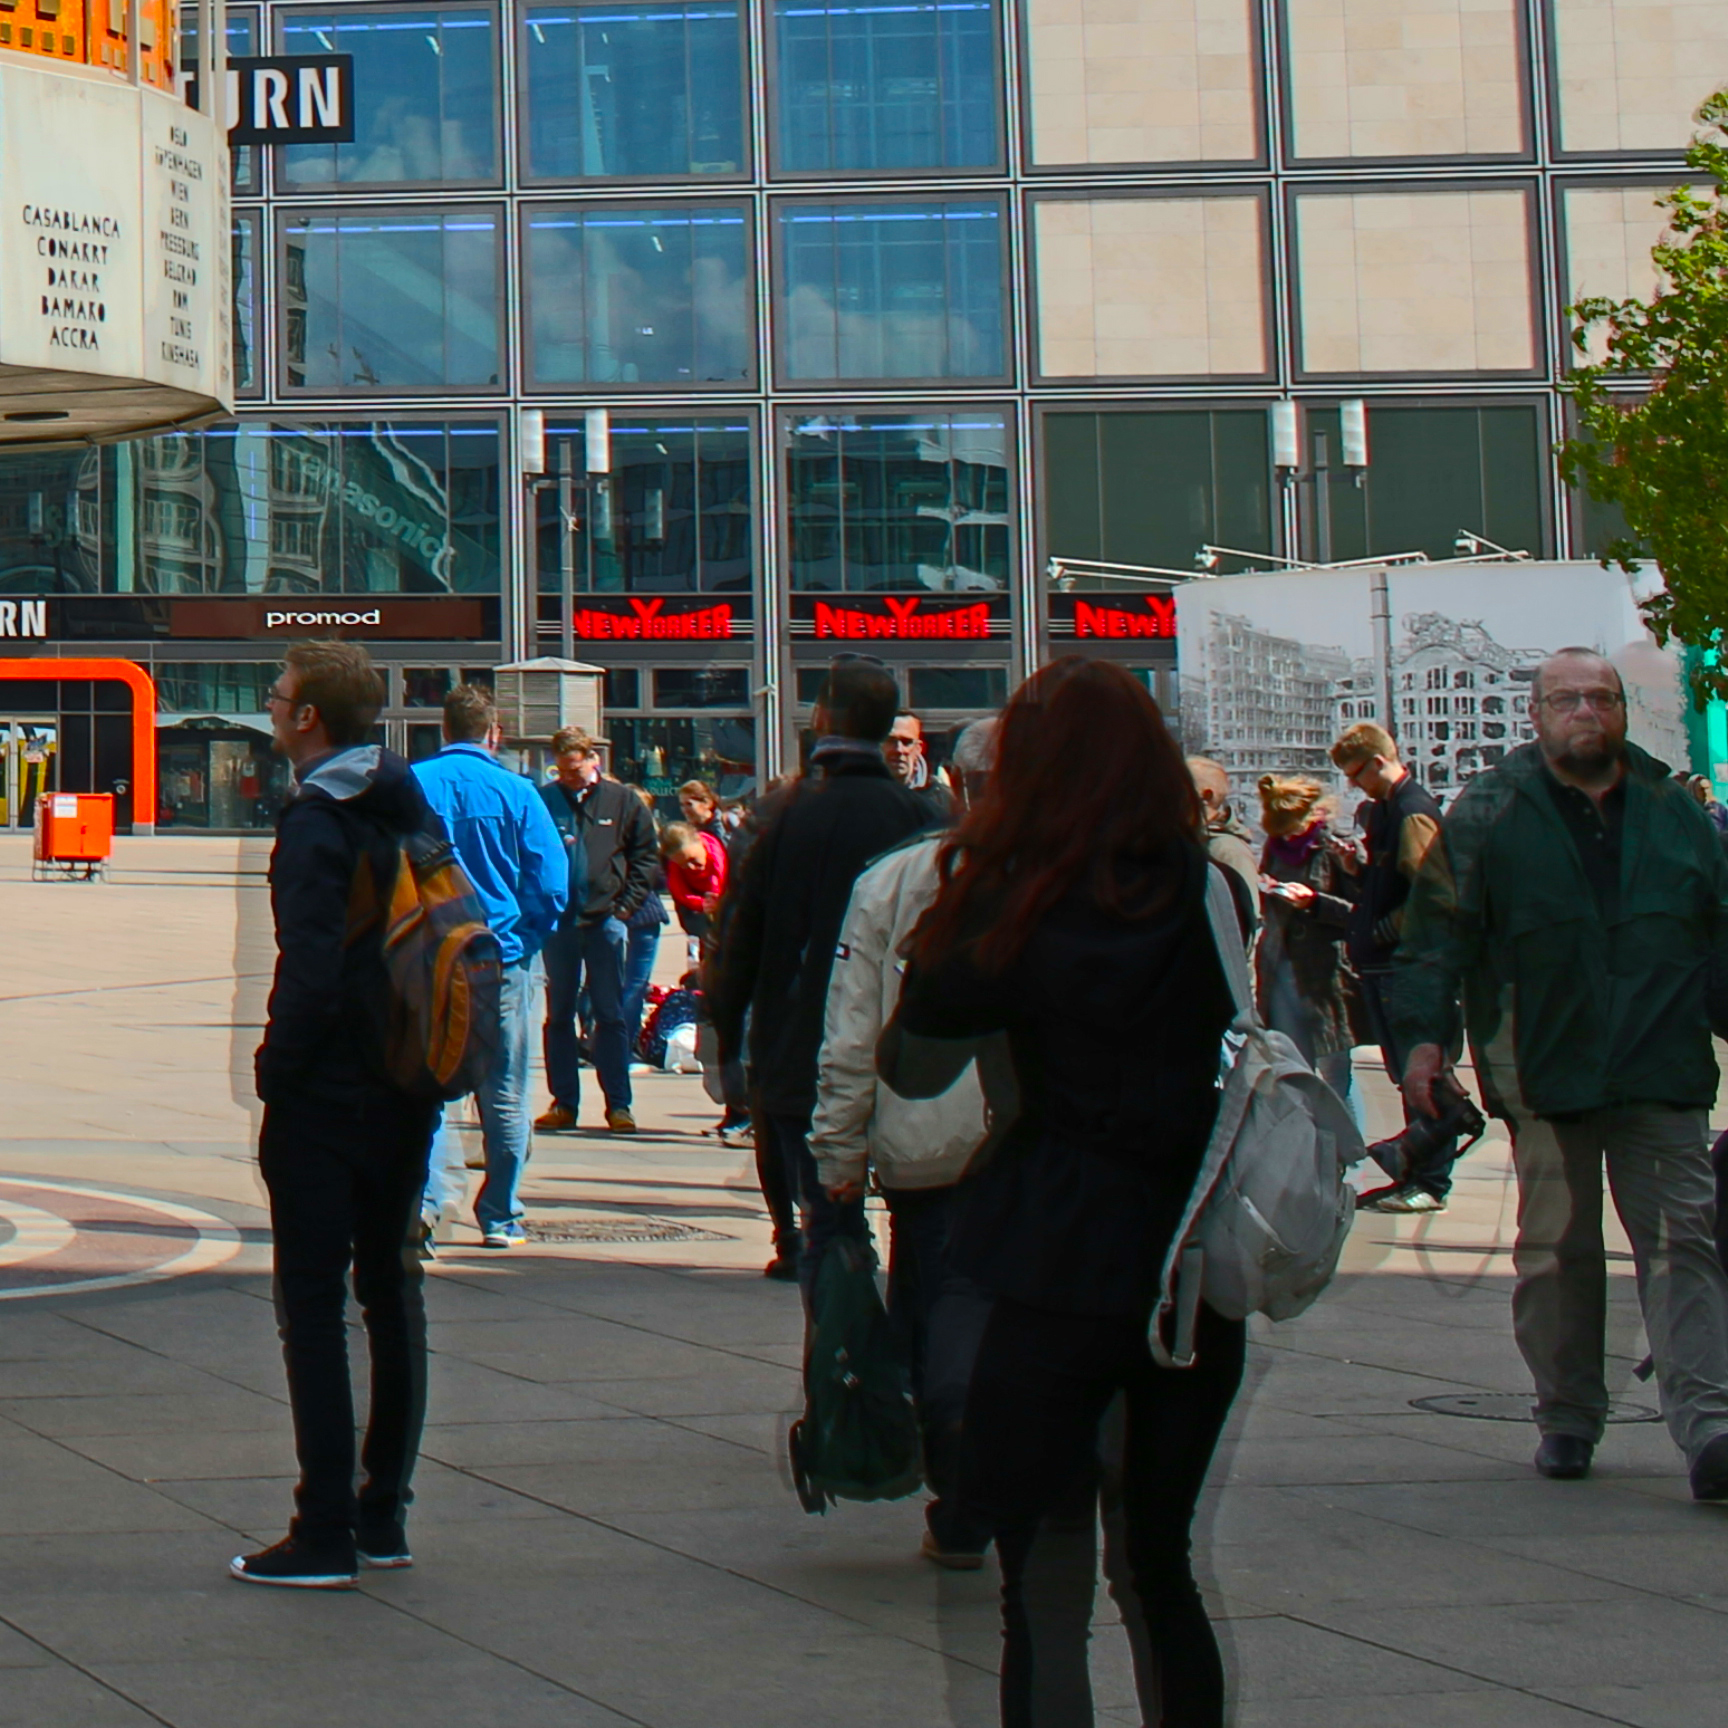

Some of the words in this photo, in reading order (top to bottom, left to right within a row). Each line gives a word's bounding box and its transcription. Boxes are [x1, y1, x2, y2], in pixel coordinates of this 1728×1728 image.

[170, 126, 187, 147] OSLO
[171, 179, 189, 203] WIEN
[23, 204, 120, 239] CASABLANCA
[171, 207, 189, 229] BERN
[37, 236, 108, 265] CONAKRY
[48, 267, 100, 293] DAKAR
[164, 260, 196, 286] BELGRAD
[41, 295, 105, 322] BAMAKO
[173, 289, 188, 312] ROM
[50, 326, 99, 350] ACCRA
[171, 316, 191, 339] TUNIS
[162, 342, 198, 369] KINSHASA
[266, 608, 380, 629] promod
